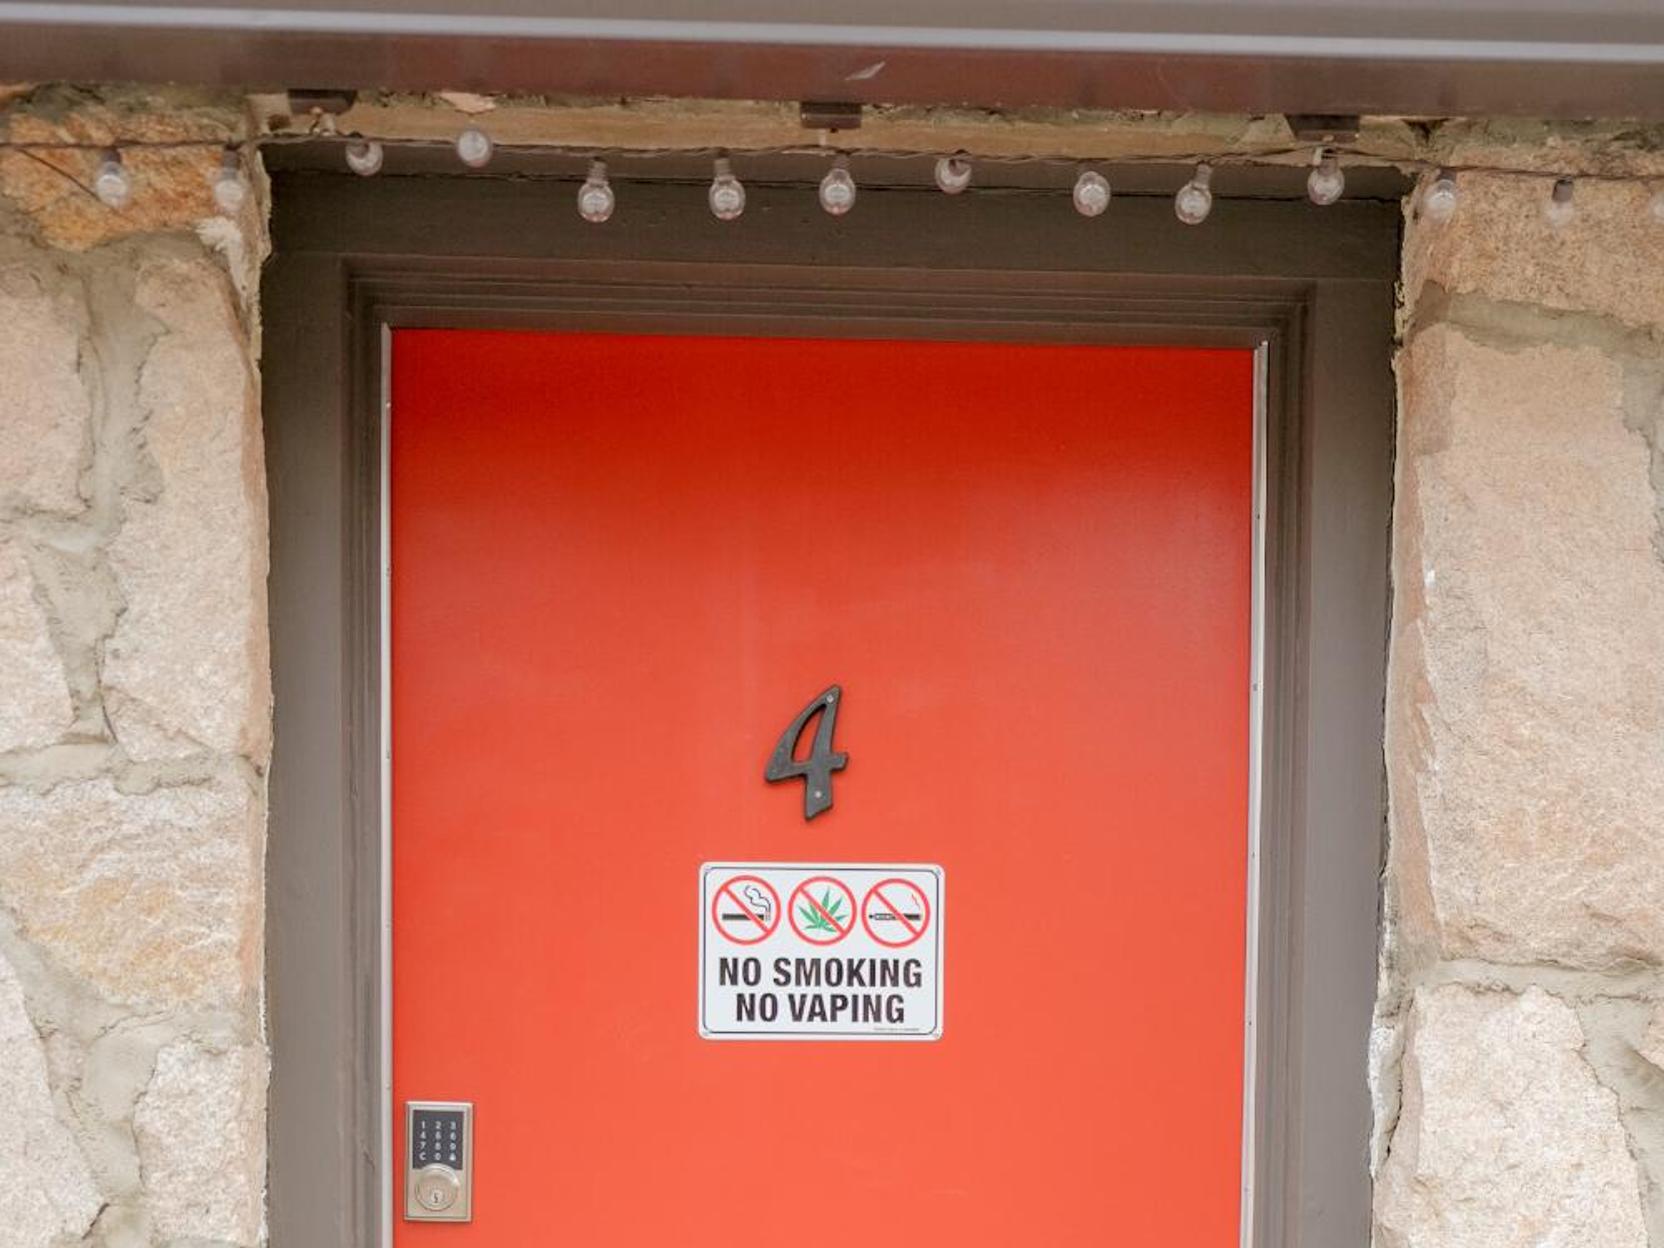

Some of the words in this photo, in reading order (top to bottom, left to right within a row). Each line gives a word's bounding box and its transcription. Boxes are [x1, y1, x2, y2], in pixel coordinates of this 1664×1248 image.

[763, 684, 849, 822] 4
[718, 957, 763, 987] NO
[772, 957, 923, 988] SMOKING
[735, 993, 779, 1023] NO
[788, 993, 906, 1024] VAPING
